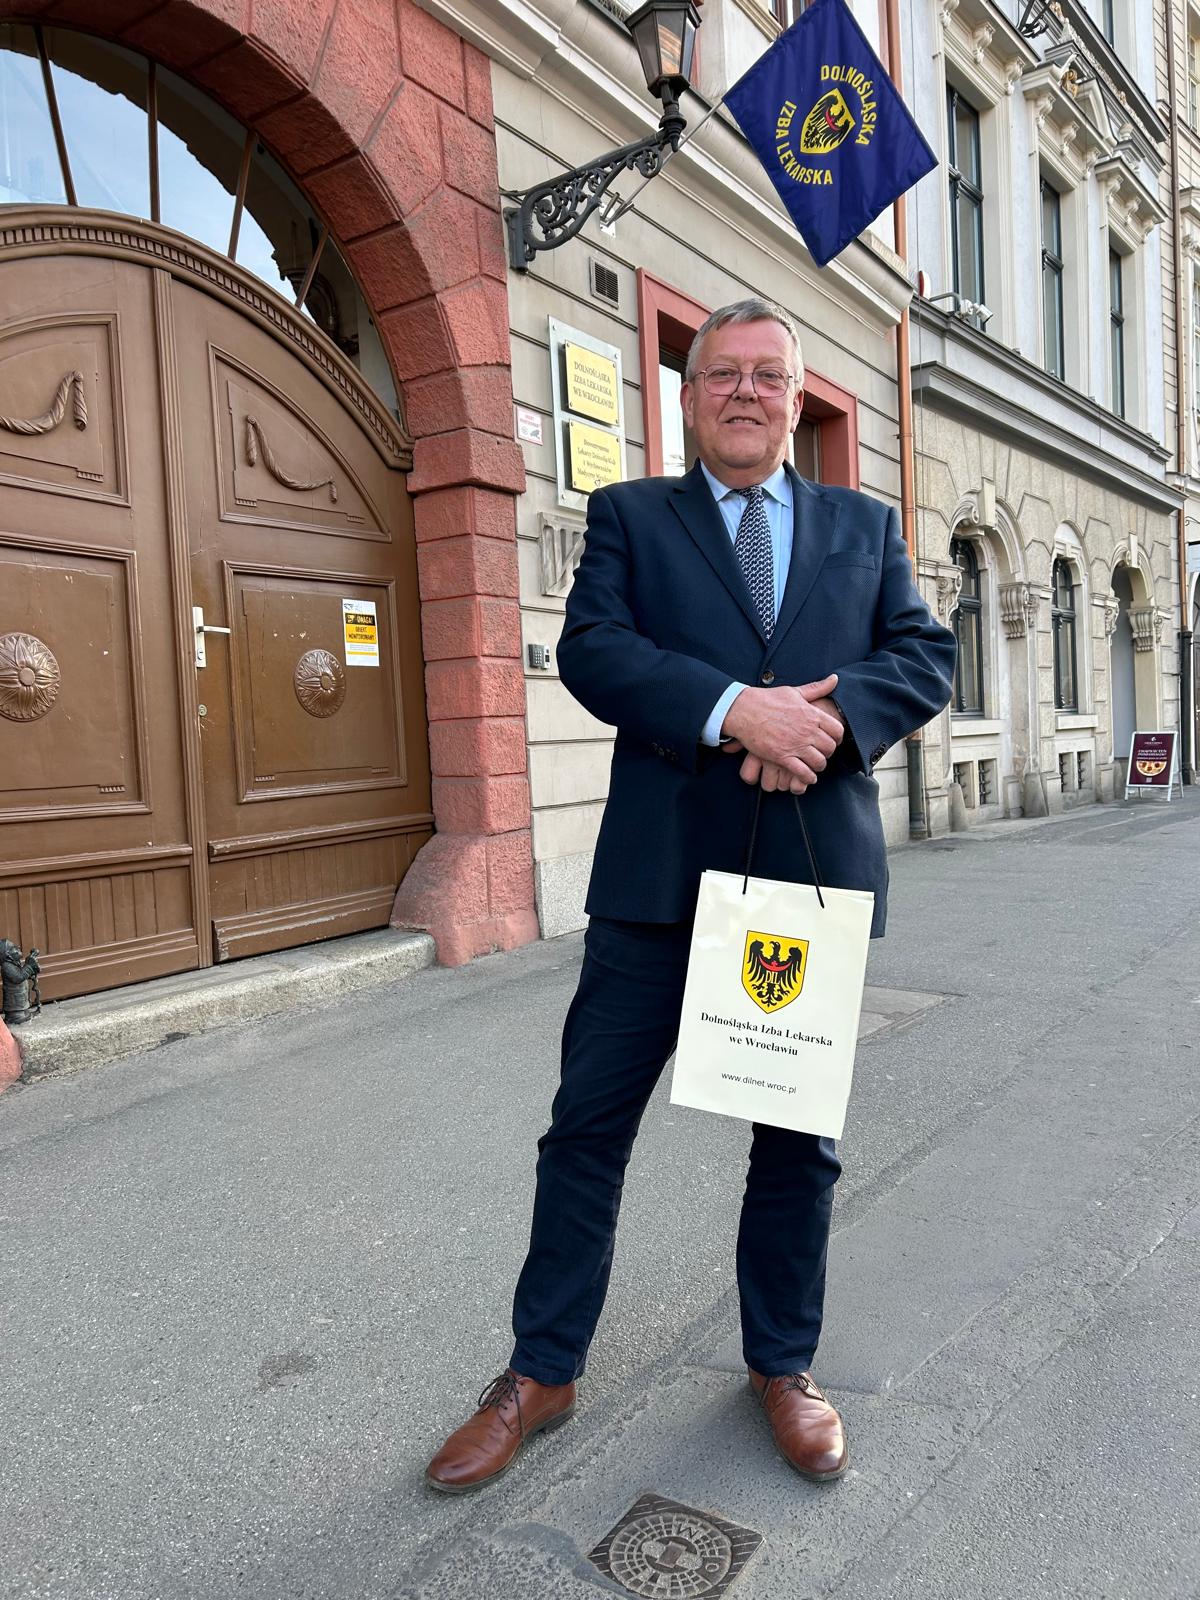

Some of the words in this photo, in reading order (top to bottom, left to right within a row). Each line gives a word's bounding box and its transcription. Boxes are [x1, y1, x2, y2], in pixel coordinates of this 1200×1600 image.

[775, 100, 797, 139] IZBA
[776, 141, 833, 185] LEKARSKA
[765, 970, 780, 985] DIL
[701, 1012, 758, 1031] Dolnośląska
[761, 1024, 782, 1036] Izba
[785, 1029, 833, 1047] Lekarska
[729, 1035, 743, 1045] we
[745, 1037, 798, 1056] Wrocławiu
[721, 1073, 797, 1095] www.dilnet.wroc.pl
